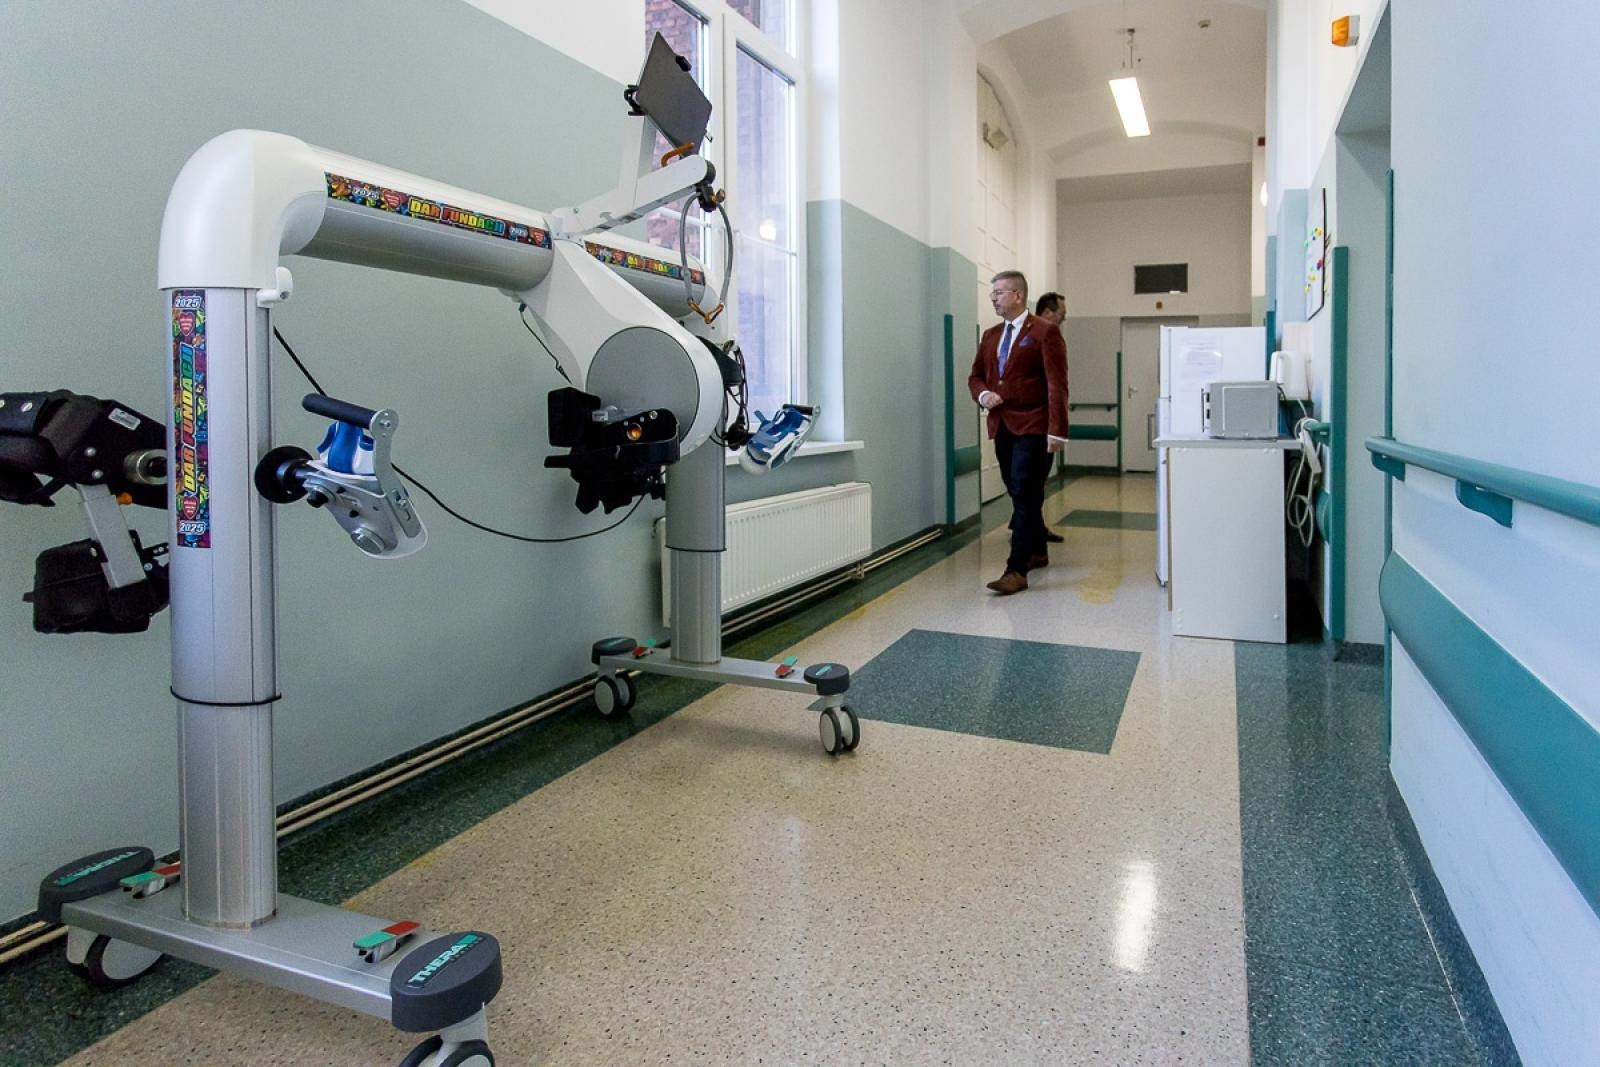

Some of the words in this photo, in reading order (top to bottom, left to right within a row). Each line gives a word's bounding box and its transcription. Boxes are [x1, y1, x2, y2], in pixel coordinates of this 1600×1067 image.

[410, 198, 441, 219] DAR
[176, 298, 200, 308] 2025
[181, 344, 195, 447] FUNDACJI
[183, 447, 196, 492] DAR
[180, 523, 204, 533] 2025
[407, 943, 469, 984] THERA
